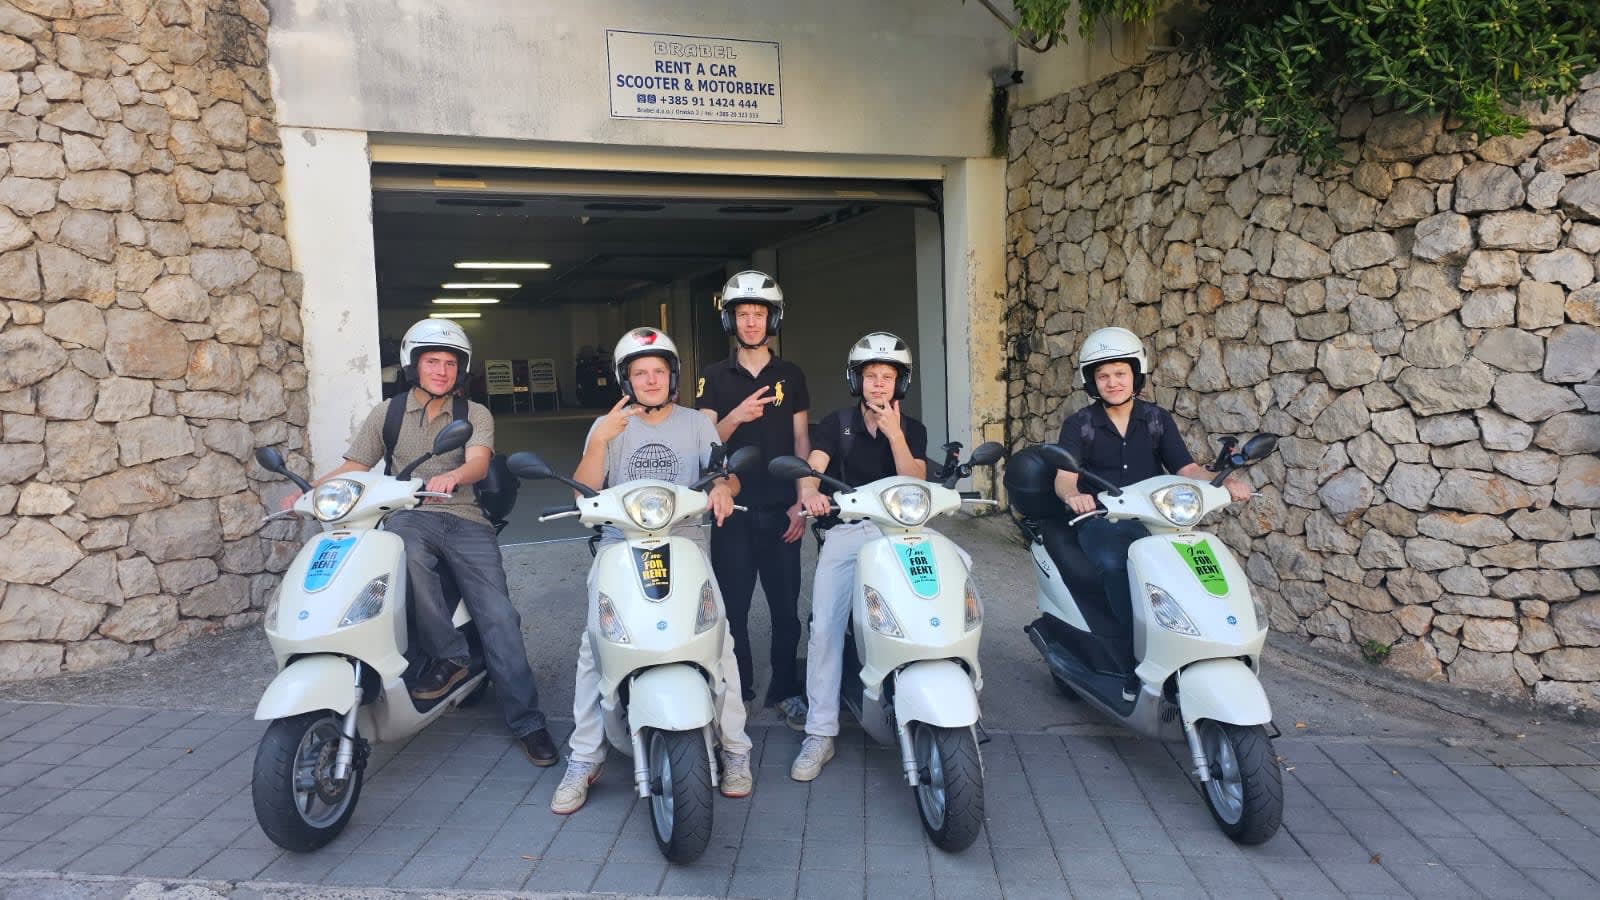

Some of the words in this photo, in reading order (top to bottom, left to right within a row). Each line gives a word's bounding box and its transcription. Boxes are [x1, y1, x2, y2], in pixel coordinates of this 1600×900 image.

[653, 41, 737, 59] BRABEL
[655, 60, 692, 75] RENT
[696, 63, 706, 76] A
[710, 63, 737, 78] CAR
[616, 74, 680, 90] SCOOTER
[684, 79, 694, 91] &
[698, 80, 775, 96] MOTORBIKE
[660, 95, 688, 106] +385
[692, 97, 705, 107] 91
[709, 98, 735, 109] 1424
[738, 100, 758, 109] 444
[634, 459, 673, 469] adidas
[644, 559, 664, 570] FOR
[909, 556, 929, 566] FOR
[1192, 555, 1213, 566] FOR
[642, 568, 668, 580] RENT
[910, 565, 933, 576] RENT
[1195, 565, 1220, 576] RENT
